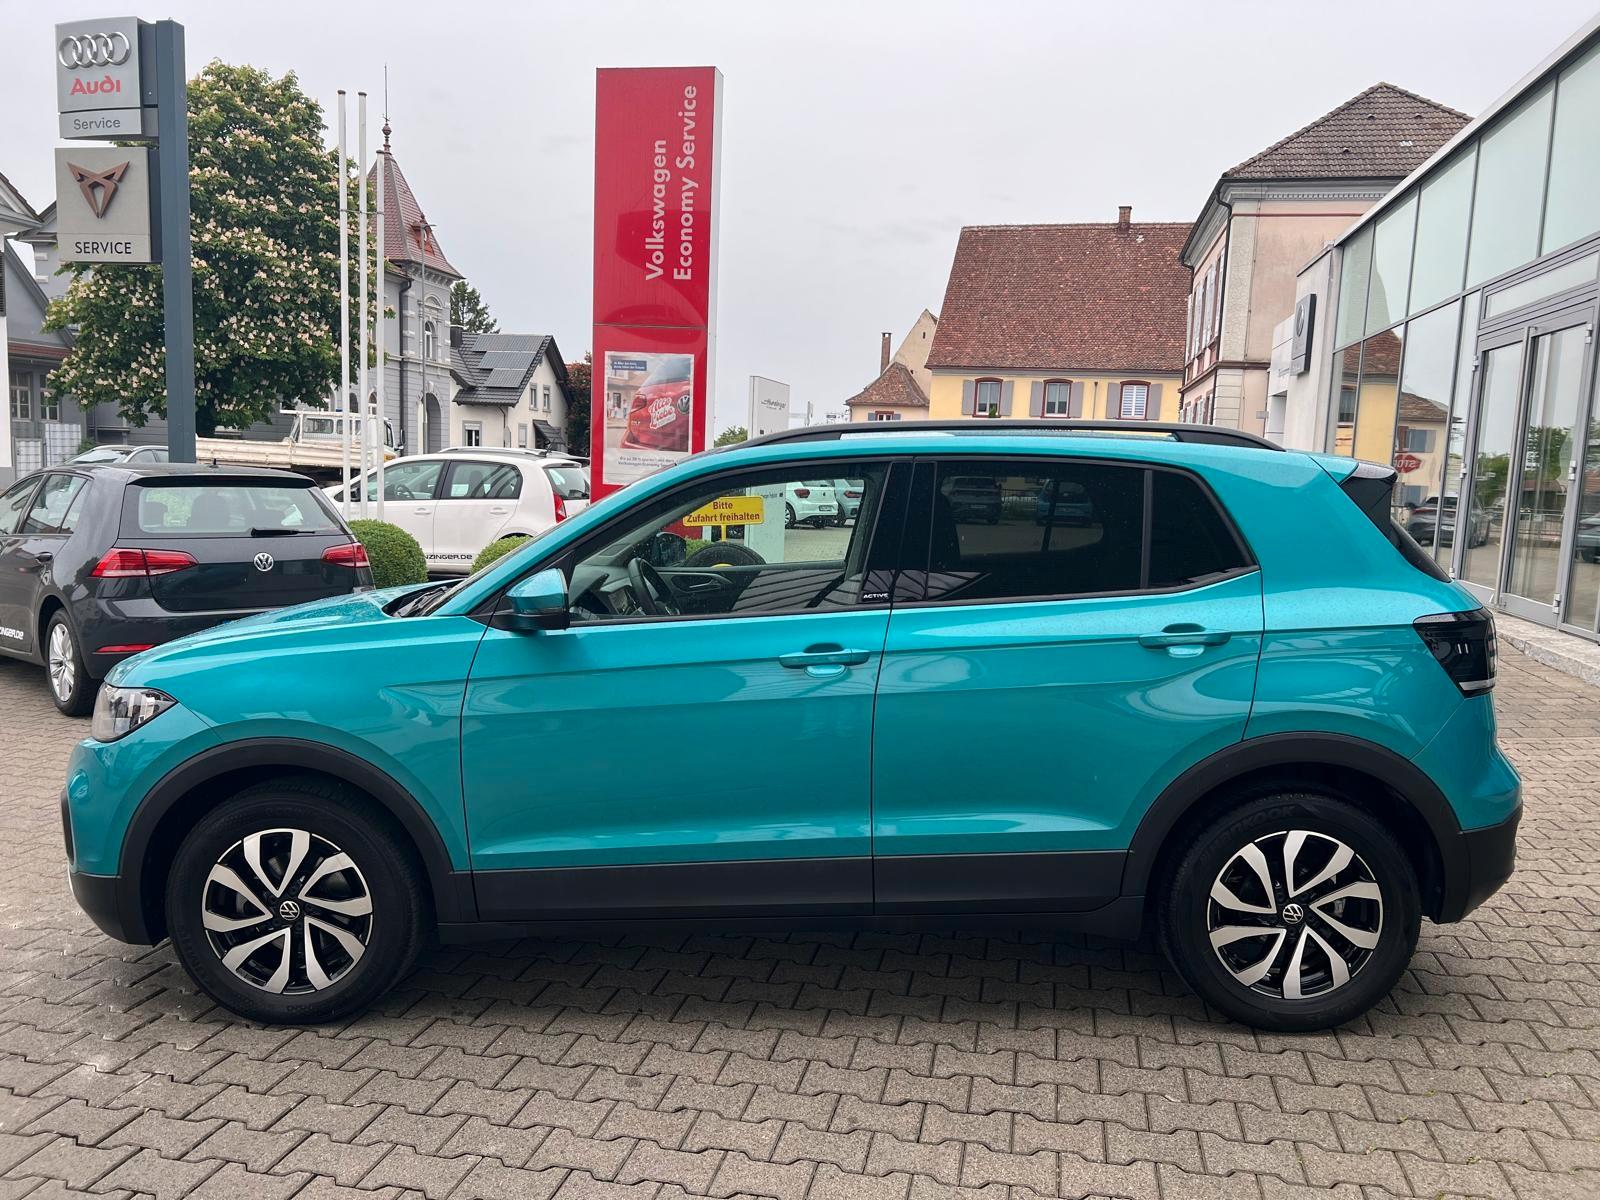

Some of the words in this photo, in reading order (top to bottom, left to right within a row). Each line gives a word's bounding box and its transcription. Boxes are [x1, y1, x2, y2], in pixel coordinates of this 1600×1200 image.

[70, 76, 121, 95] Audi
[73, 117, 121, 130] Service
[675, 85, 697, 169] Service
[645, 140, 670, 280] Volkswagen
[673, 177, 698, 280] Economy
[75, 241, 132, 254] SERVICE
[713, 501, 733, 510] Bitte
[687, 514, 718, 523] Zufahrt
[719, 512, 760, 521] freihalten
